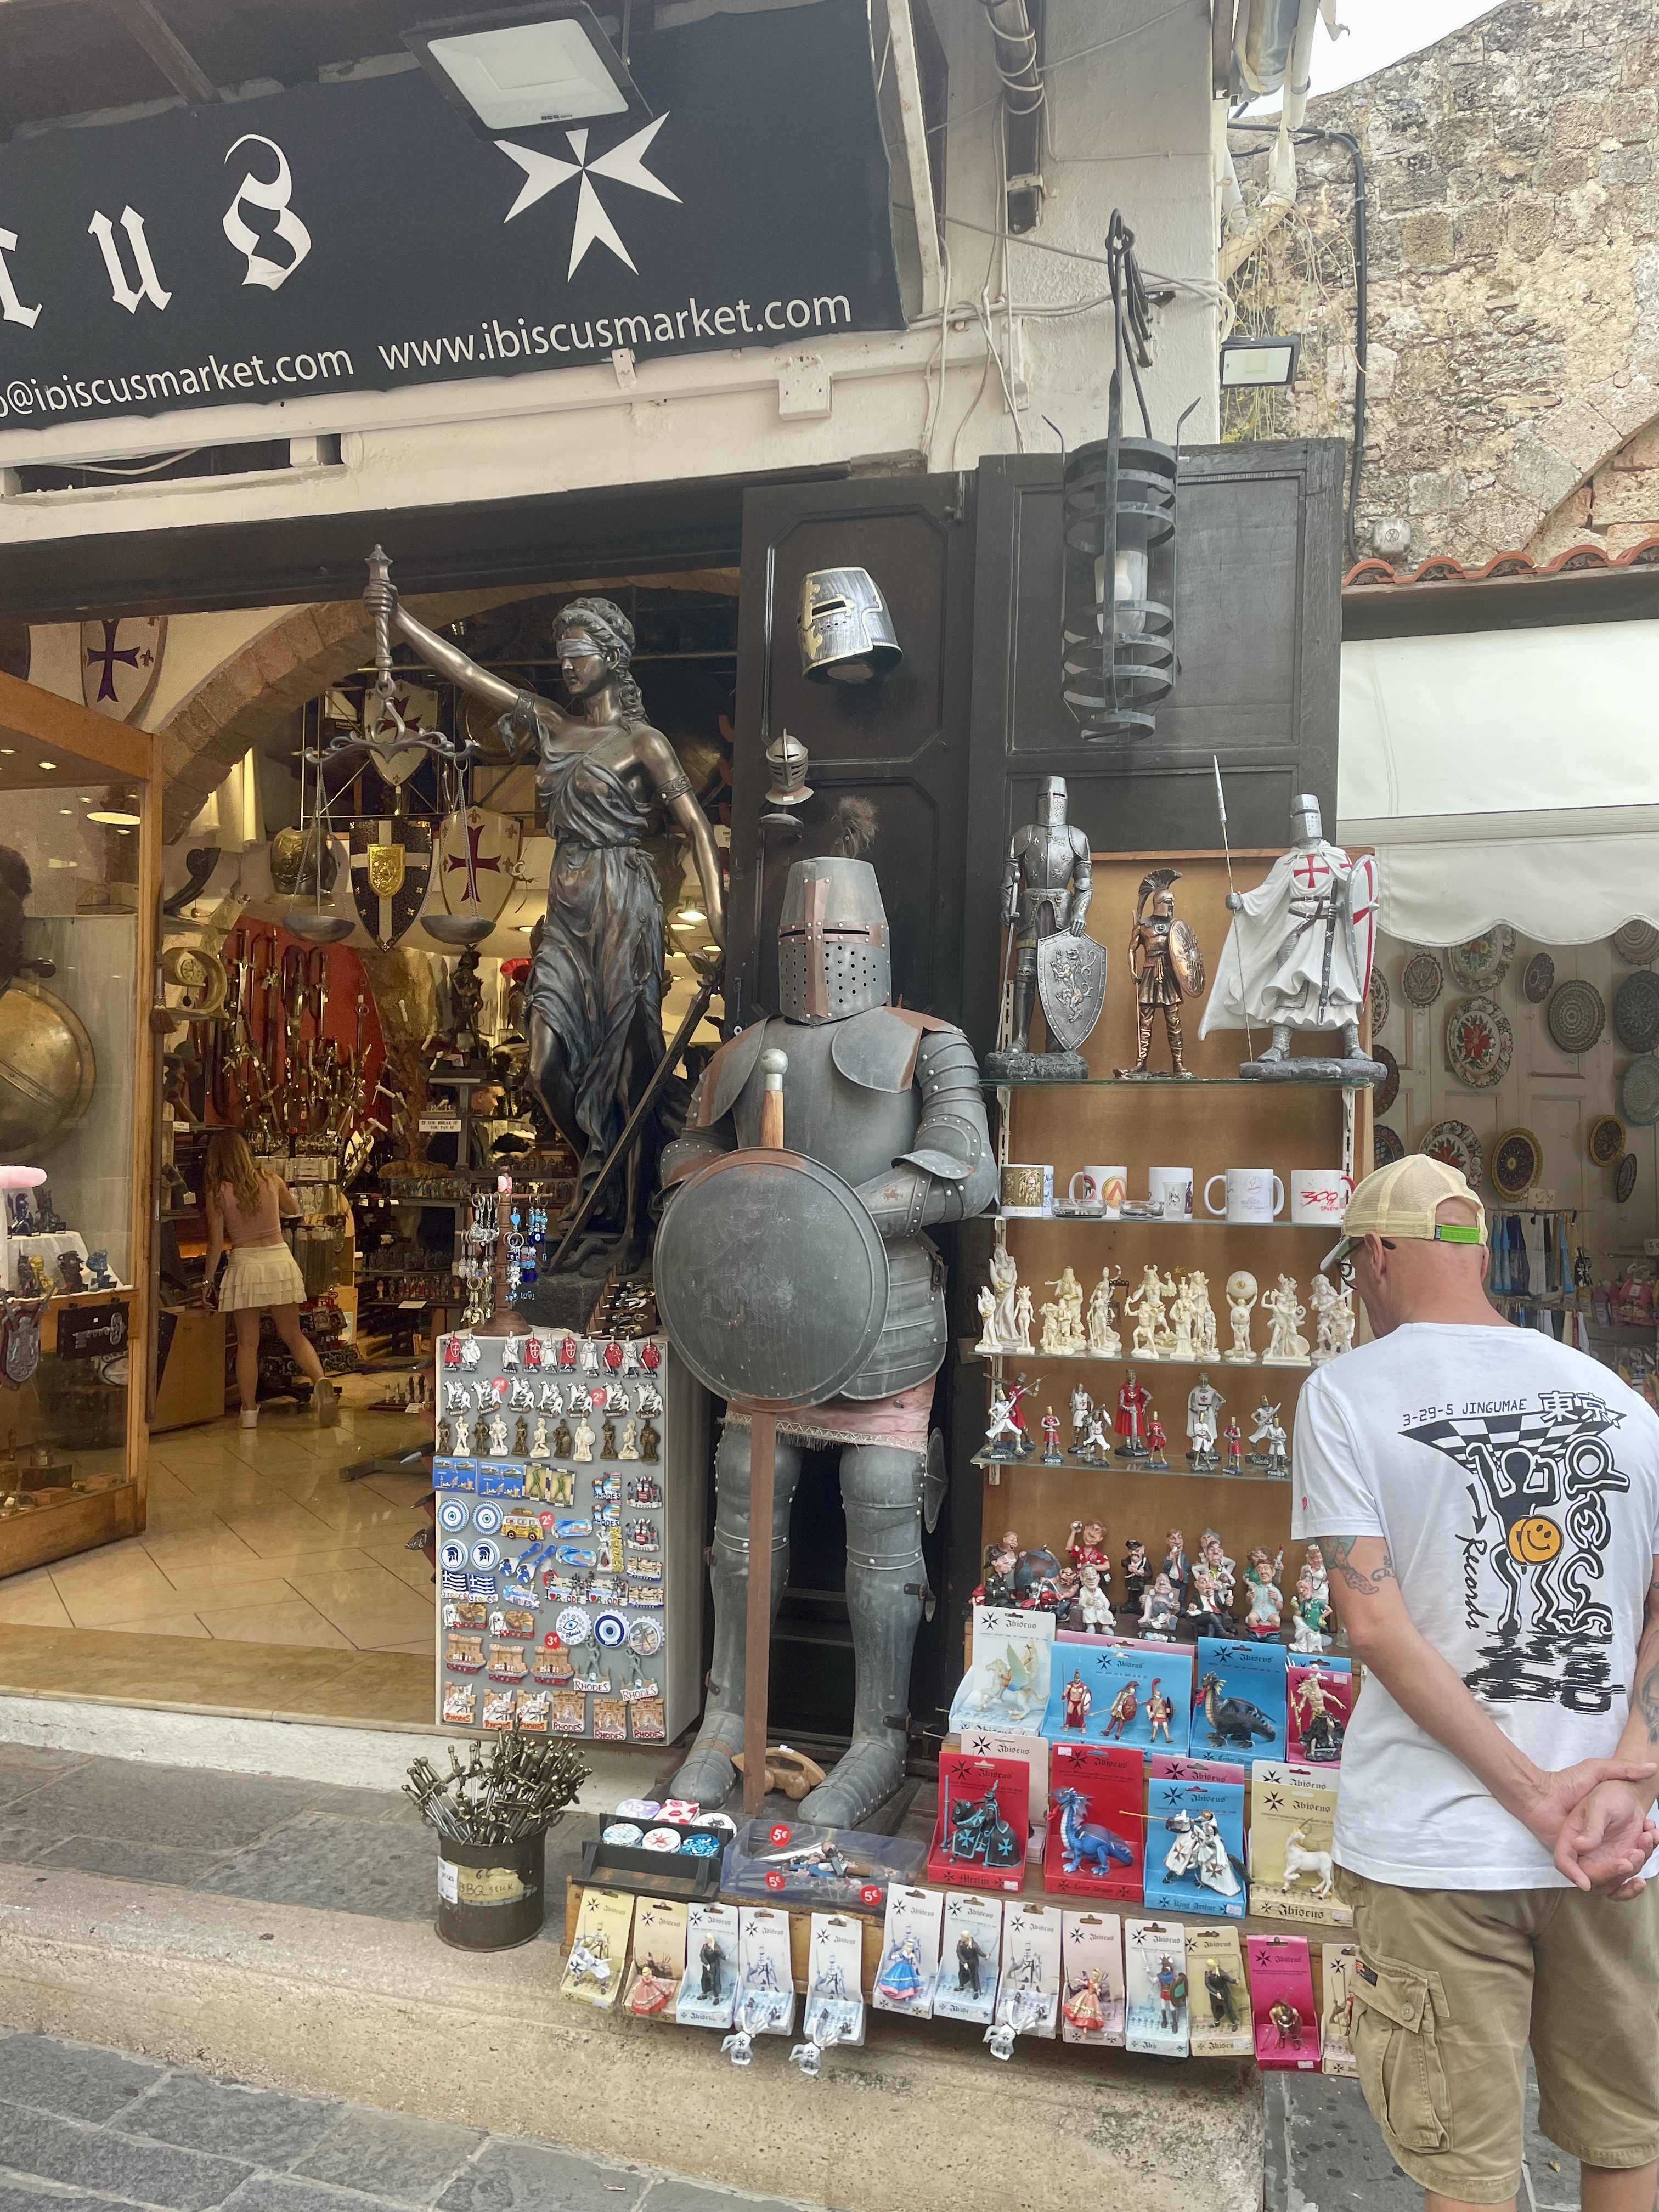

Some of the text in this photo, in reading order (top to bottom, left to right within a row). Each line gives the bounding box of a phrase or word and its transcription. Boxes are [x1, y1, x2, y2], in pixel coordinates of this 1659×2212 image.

[378, 295, 851, 370] www.ibiscusmarket.com
[495, 1381, 505, 1390] 2€
[593, 1392, 603, 1402] 2€
[1402, 1398, 1528, 1426] 3-29-5 JINGUMAE
[541, 1514, 552, 1526] 2€
[1454, 1534, 1489, 1629] Records
[441, 1588, 468, 1598] Greece
[468, 1593, 496, 1602] Greece
[1005, 1619, 1037, 1629] Ibiscus
[547, 1635, 558, 1646] 3€
[1239, 1653, 1274, 1663] Ibiscus
[1116, 1660, 1144, 1668] Ibiscus
[575, 1682, 609, 1692] RHODES
[622, 1685, 657, 1700] RHODES
[445, 1713, 471, 1722] RHODES
[553, 1722, 582, 1731] RHODES
[595, 1730, 625, 1740] RHODES
[634, 1729, 664, 1738] RHODES
[997, 1742, 1030, 1754] Ibiscus
[1094, 1757, 1128, 1769] Ibiscus
[978, 1768, 1013, 1780] Ibiscus
[1192, 1771, 1227, 1782] Ibiscus
[1190, 1793, 1227, 1803] Ibiscus
[1293, 1800, 1331, 1813] Ibiscus
[772, 1829, 788, 1841] 5€
[768, 1876, 781, 1887] 5€
[958, 1874, 989, 1886] Merlin
[459, 1882, 485, 1895] BBQ
[864, 1889, 878, 1902] 5€
[1192, 1902, 1216, 1912] Arthur
[1278, 1904, 1324, 1919] Ibiscus
